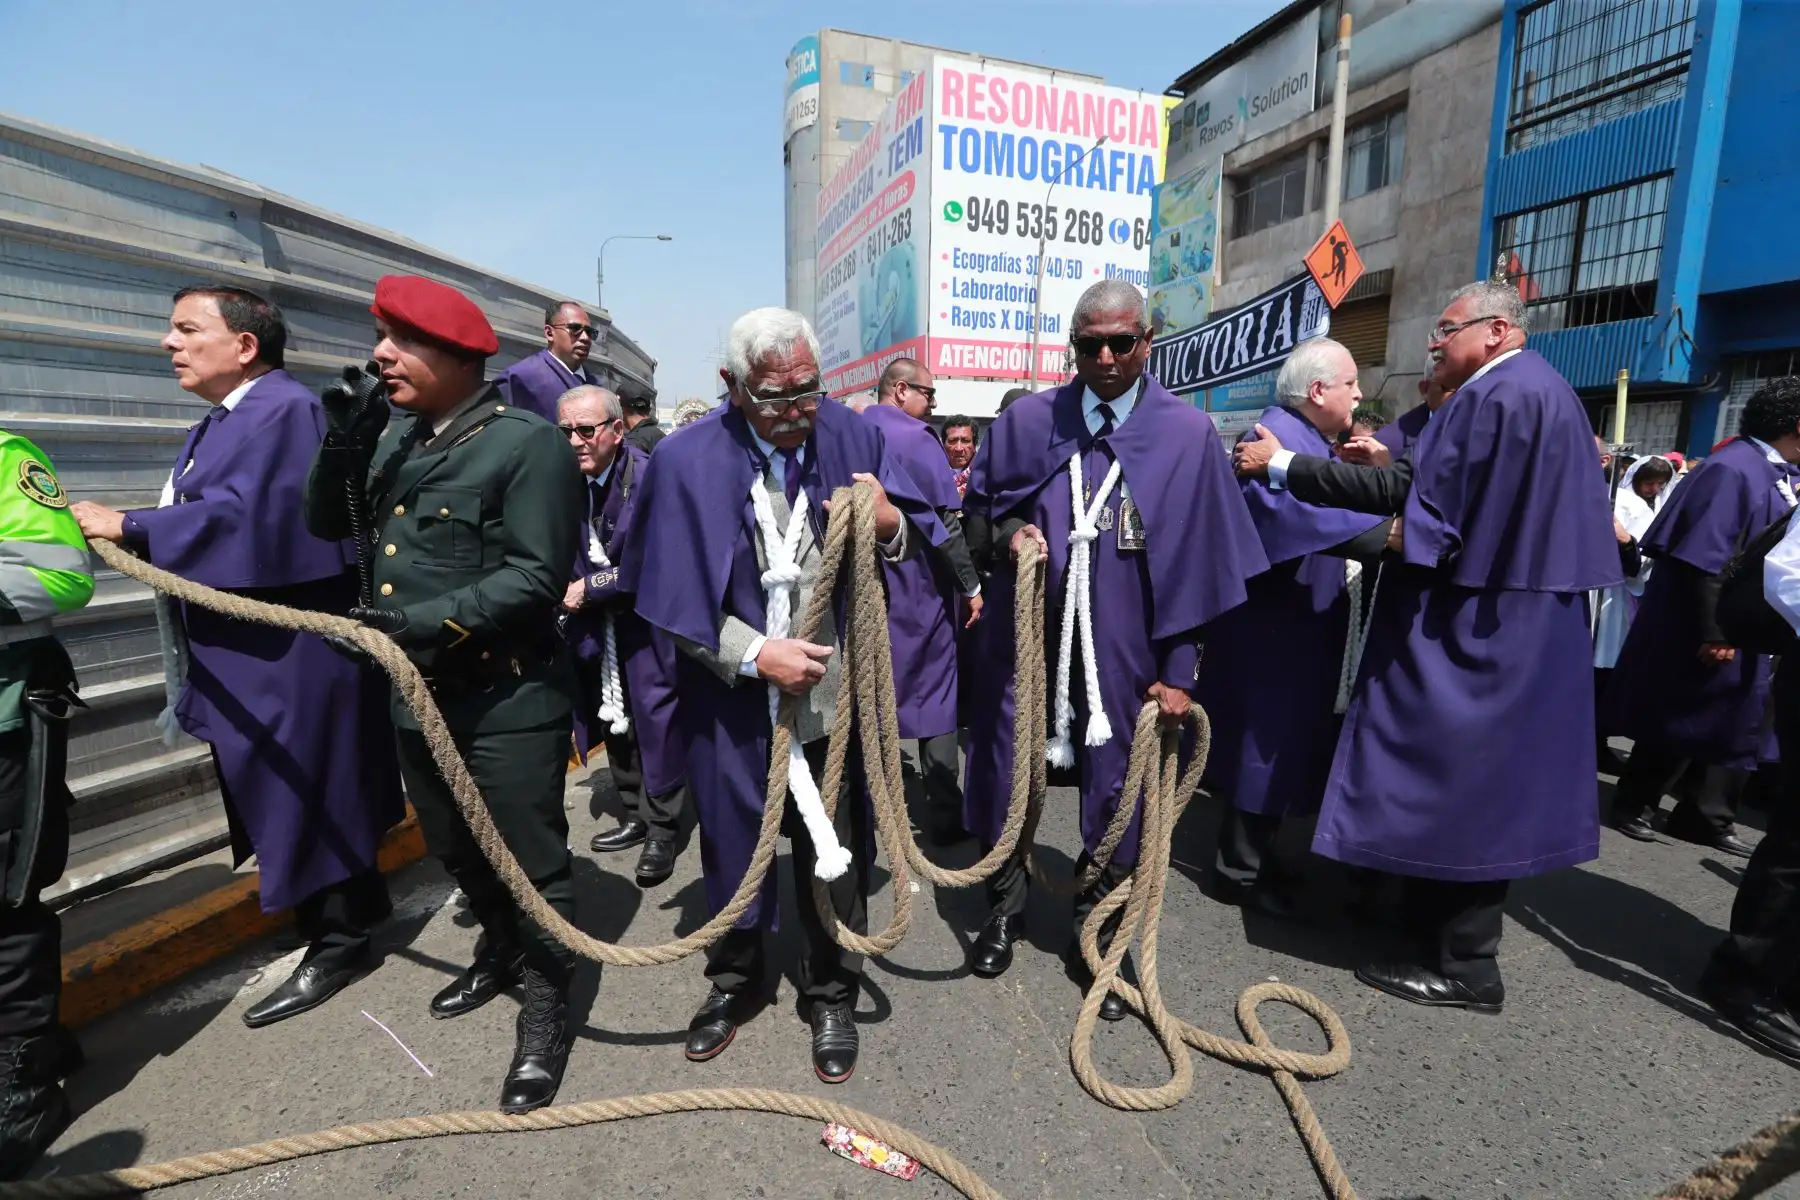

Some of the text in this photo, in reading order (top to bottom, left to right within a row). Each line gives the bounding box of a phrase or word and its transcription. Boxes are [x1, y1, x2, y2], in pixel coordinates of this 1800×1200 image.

[895, 70, 925, 133] RM
[941, 68, 1158, 148] RESONANCIA
[1200, 114, 1234, 147] Rayos
[1251, 71, 1308, 118] Solution
[888, 115, 923, 179] TEM
[938, 124, 1156, 196] TOMOGRAFIA
[868, 207, 912, 264] 6411-263
[967, 196, 1009, 236] 949
[1016, 202, 1058, 241] 535
[1064, 208, 1103, 246] 268
[952, 276, 1038, 304] Laboratorio
[953, 247, 1083, 281] Ecografías 3D/4D/5D
[951, 305, 1061, 334] Rayos X Digital
[1165, 291, 1293, 387] VICTORIA
[938, 341, 1032, 371] ATENCIÓN
